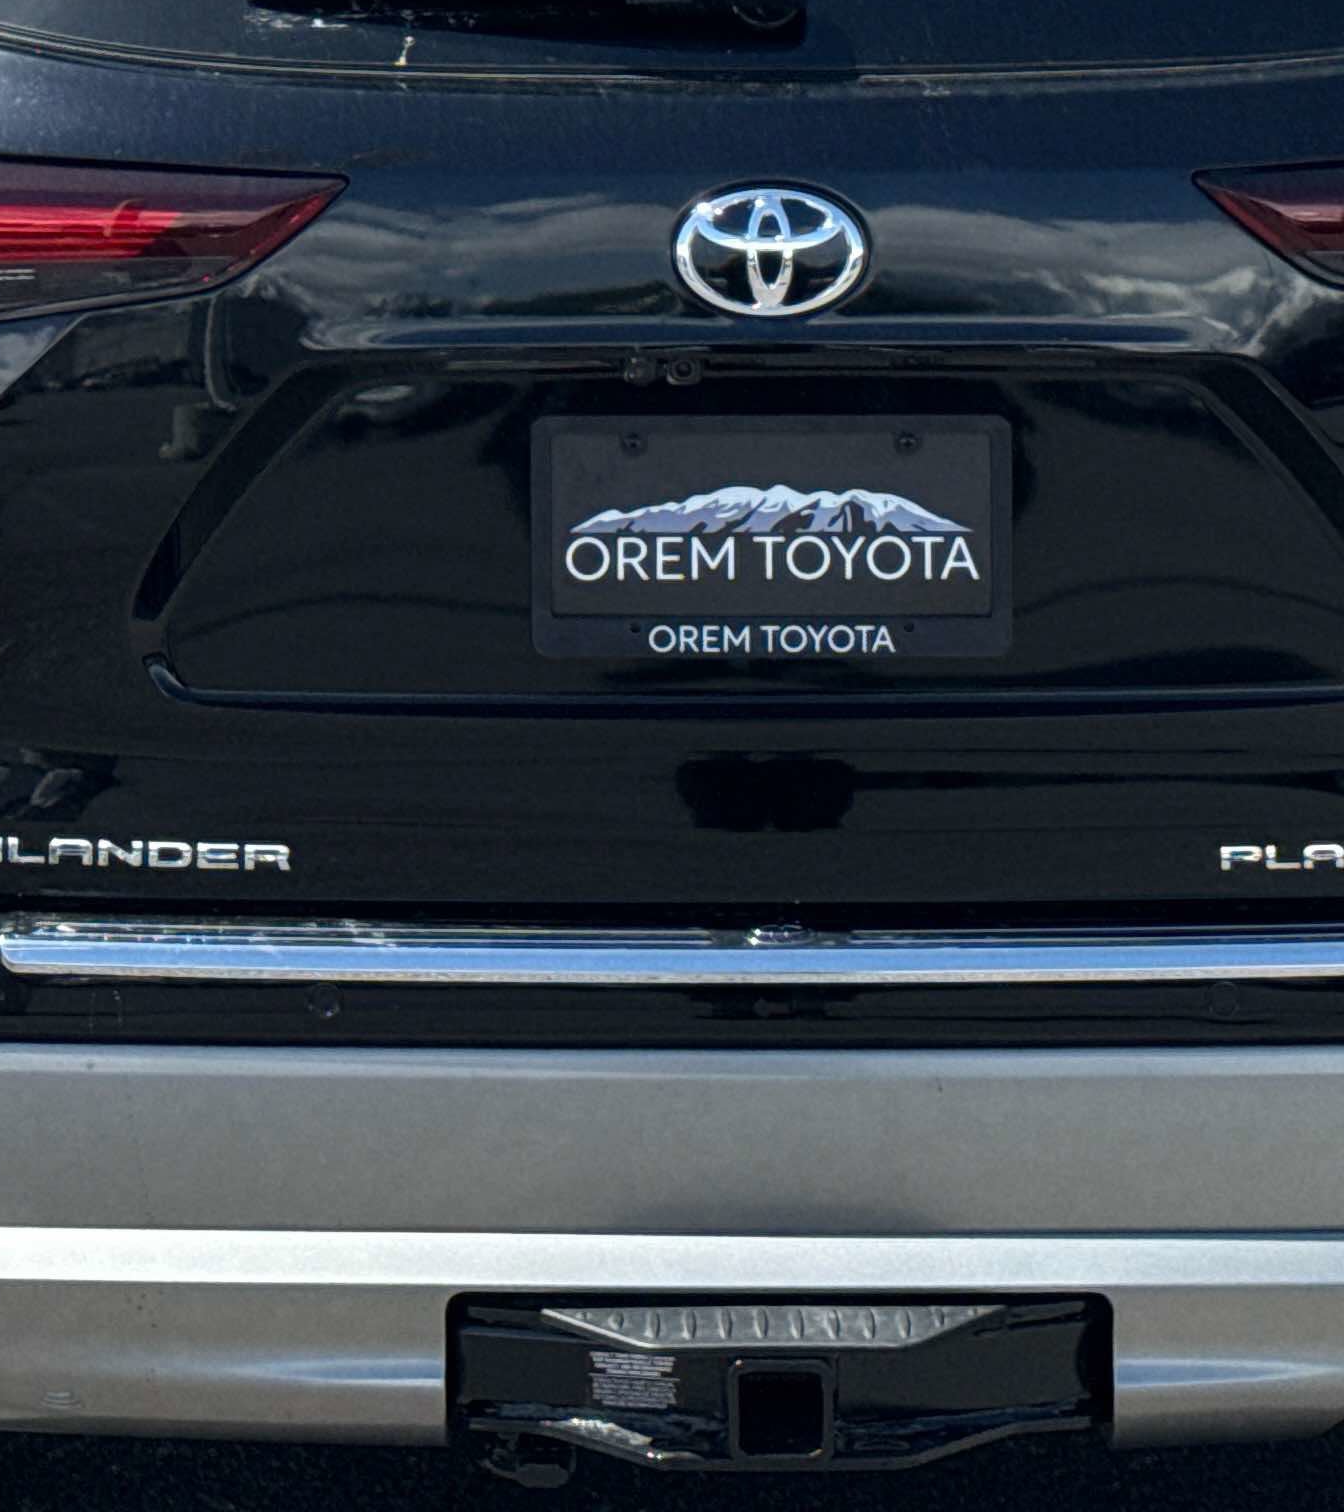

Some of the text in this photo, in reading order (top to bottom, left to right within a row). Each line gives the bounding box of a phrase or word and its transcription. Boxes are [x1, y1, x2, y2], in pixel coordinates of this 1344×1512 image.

[565, 536, 980, 582] OREM TOYOTA
[648, 624, 897, 653] OREM TOYOTA
